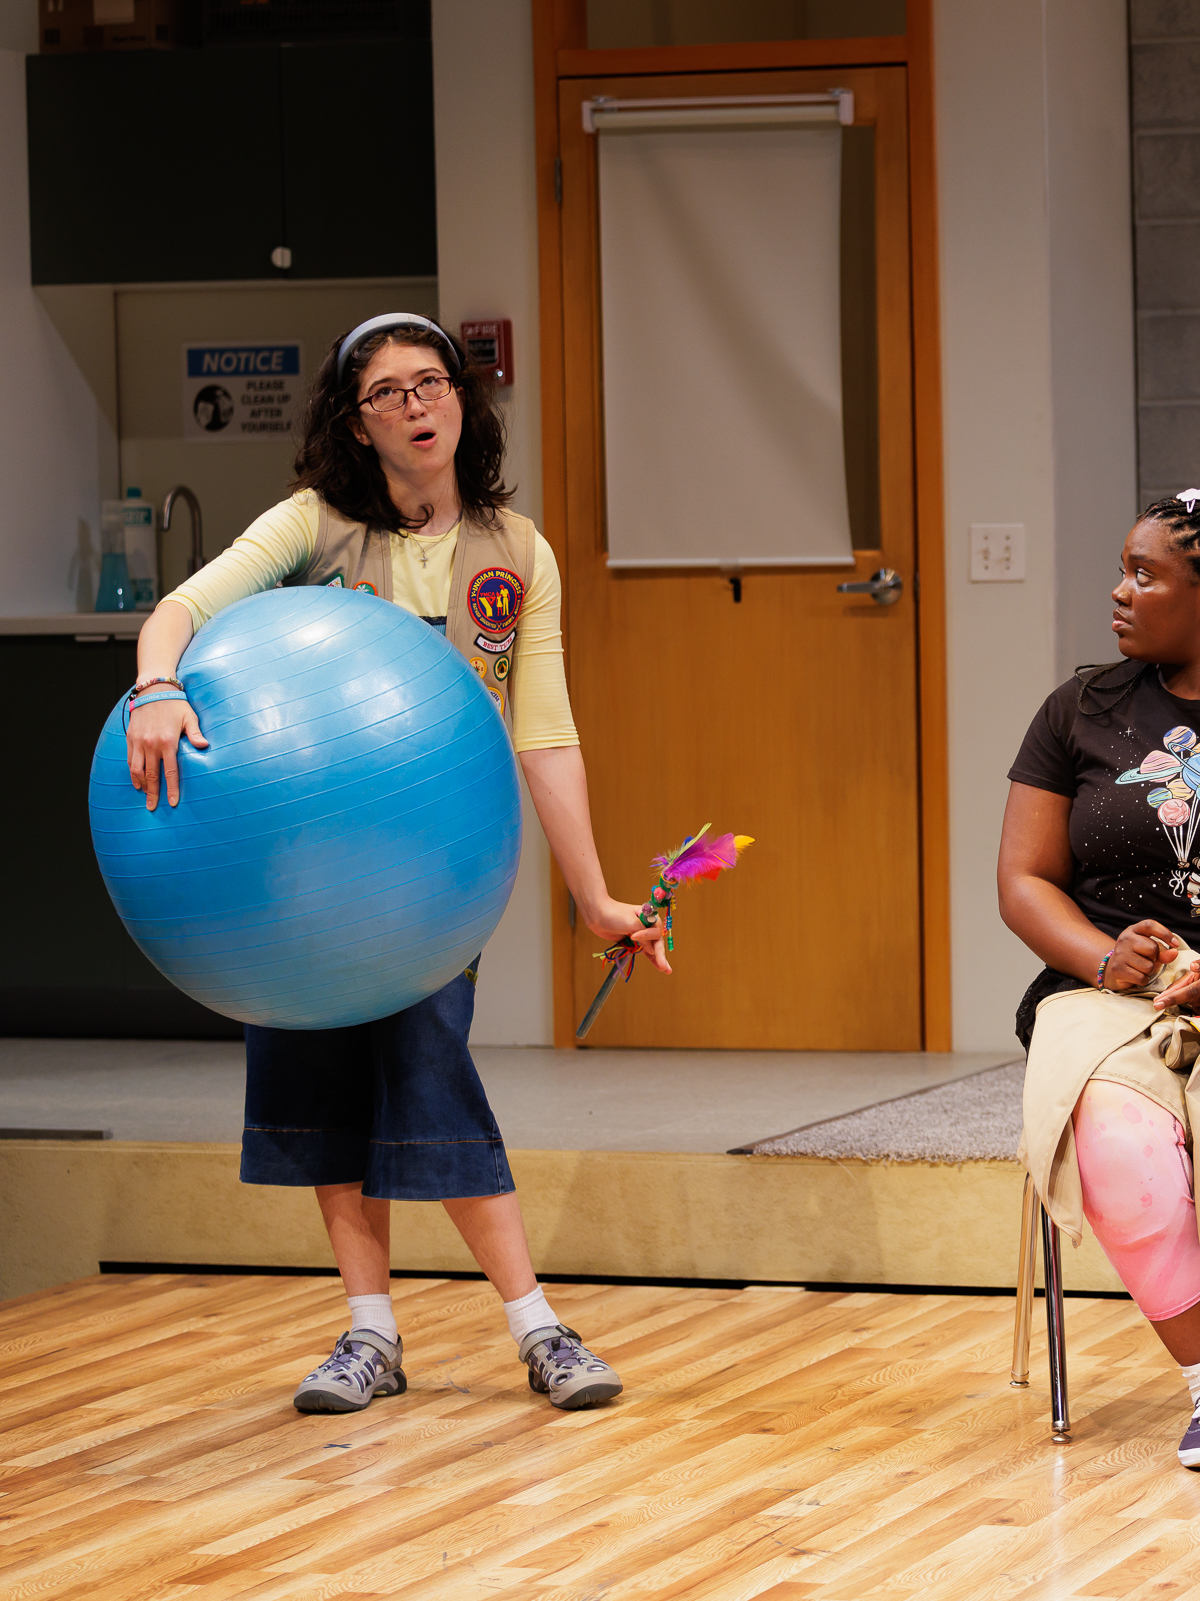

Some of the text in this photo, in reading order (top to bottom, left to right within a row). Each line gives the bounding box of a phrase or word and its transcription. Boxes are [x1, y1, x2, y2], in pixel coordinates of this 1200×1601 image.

[202, 351, 284, 373] NOTICE
[247, 381, 284, 391] PLEASE
[241, 393, 291, 405] CLEAN UP
[251, 408, 282, 418] AFTER
[241, 422, 291, 432] YOURSELF
[471, 571, 521, 597] Y-INDIAN PRINCESS
[483, 641, 498, 651] BEST
